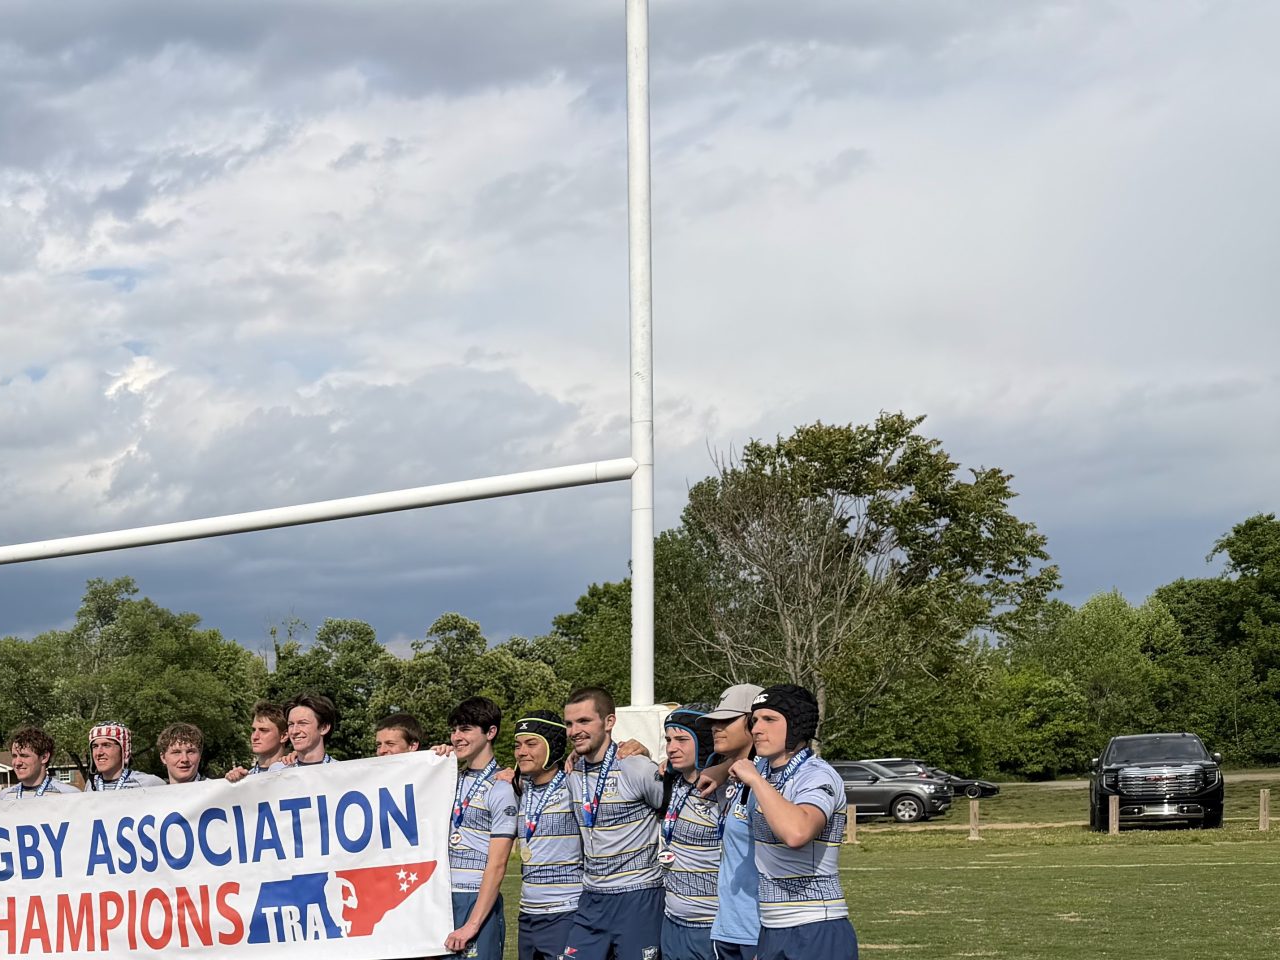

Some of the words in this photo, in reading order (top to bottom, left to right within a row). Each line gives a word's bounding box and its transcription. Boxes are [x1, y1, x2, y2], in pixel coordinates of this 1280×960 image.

[780, 748, 807, 778] CHAMPIO
[533, 782, 556, 814] CHAMPION
[87, 784, 419, 876] ASSOCIATION
[261, 903, 328, 943] TRA
